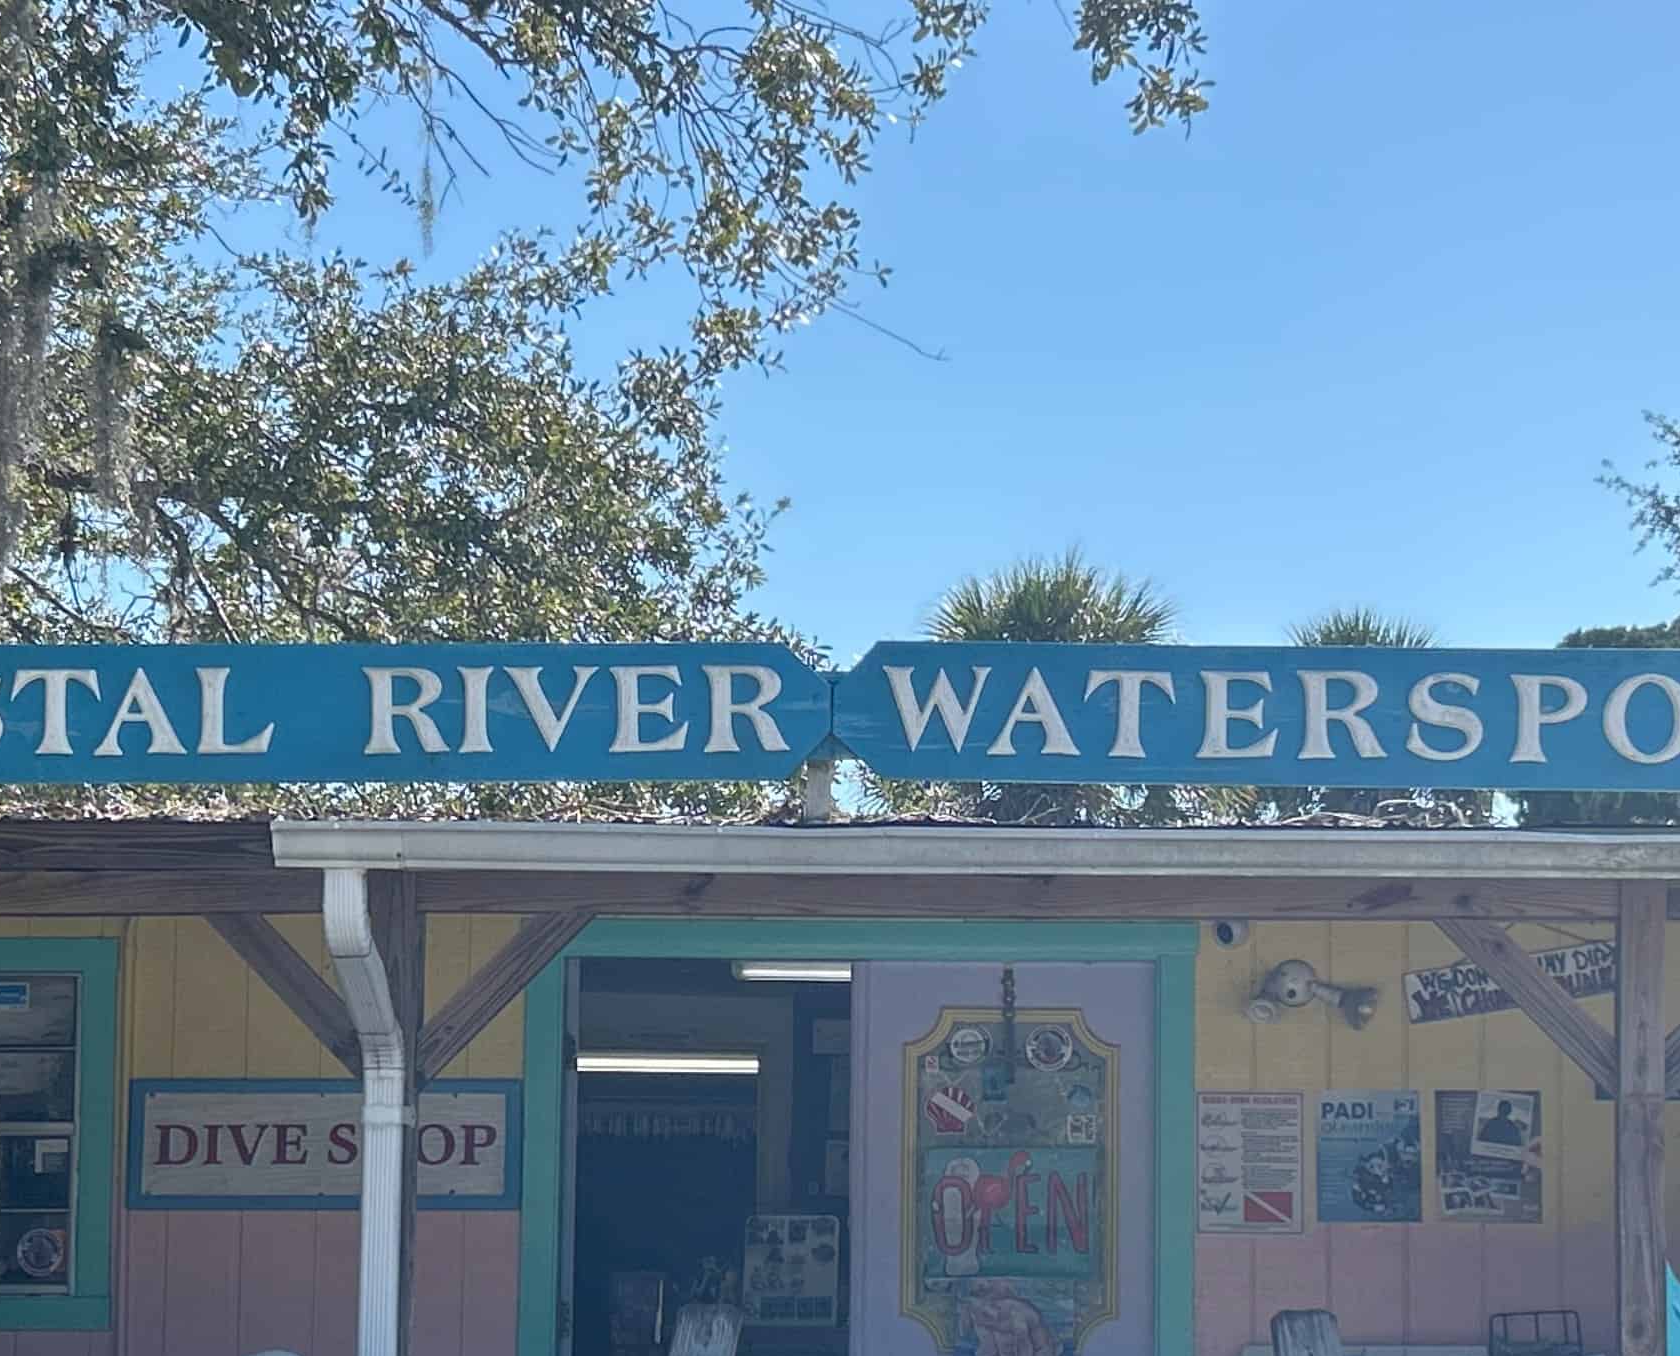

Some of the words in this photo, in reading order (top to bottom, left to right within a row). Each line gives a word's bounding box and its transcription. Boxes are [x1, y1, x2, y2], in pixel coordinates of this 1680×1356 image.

[361, 662, 793, 756] RIVER
[1321, 1101, 1374, 1120] PADI
[153, 1123, 309, 1167] DIVE
[326, 1122, 498, 1168] SOP
[931, 1170, 1091, 1258] OPEN
